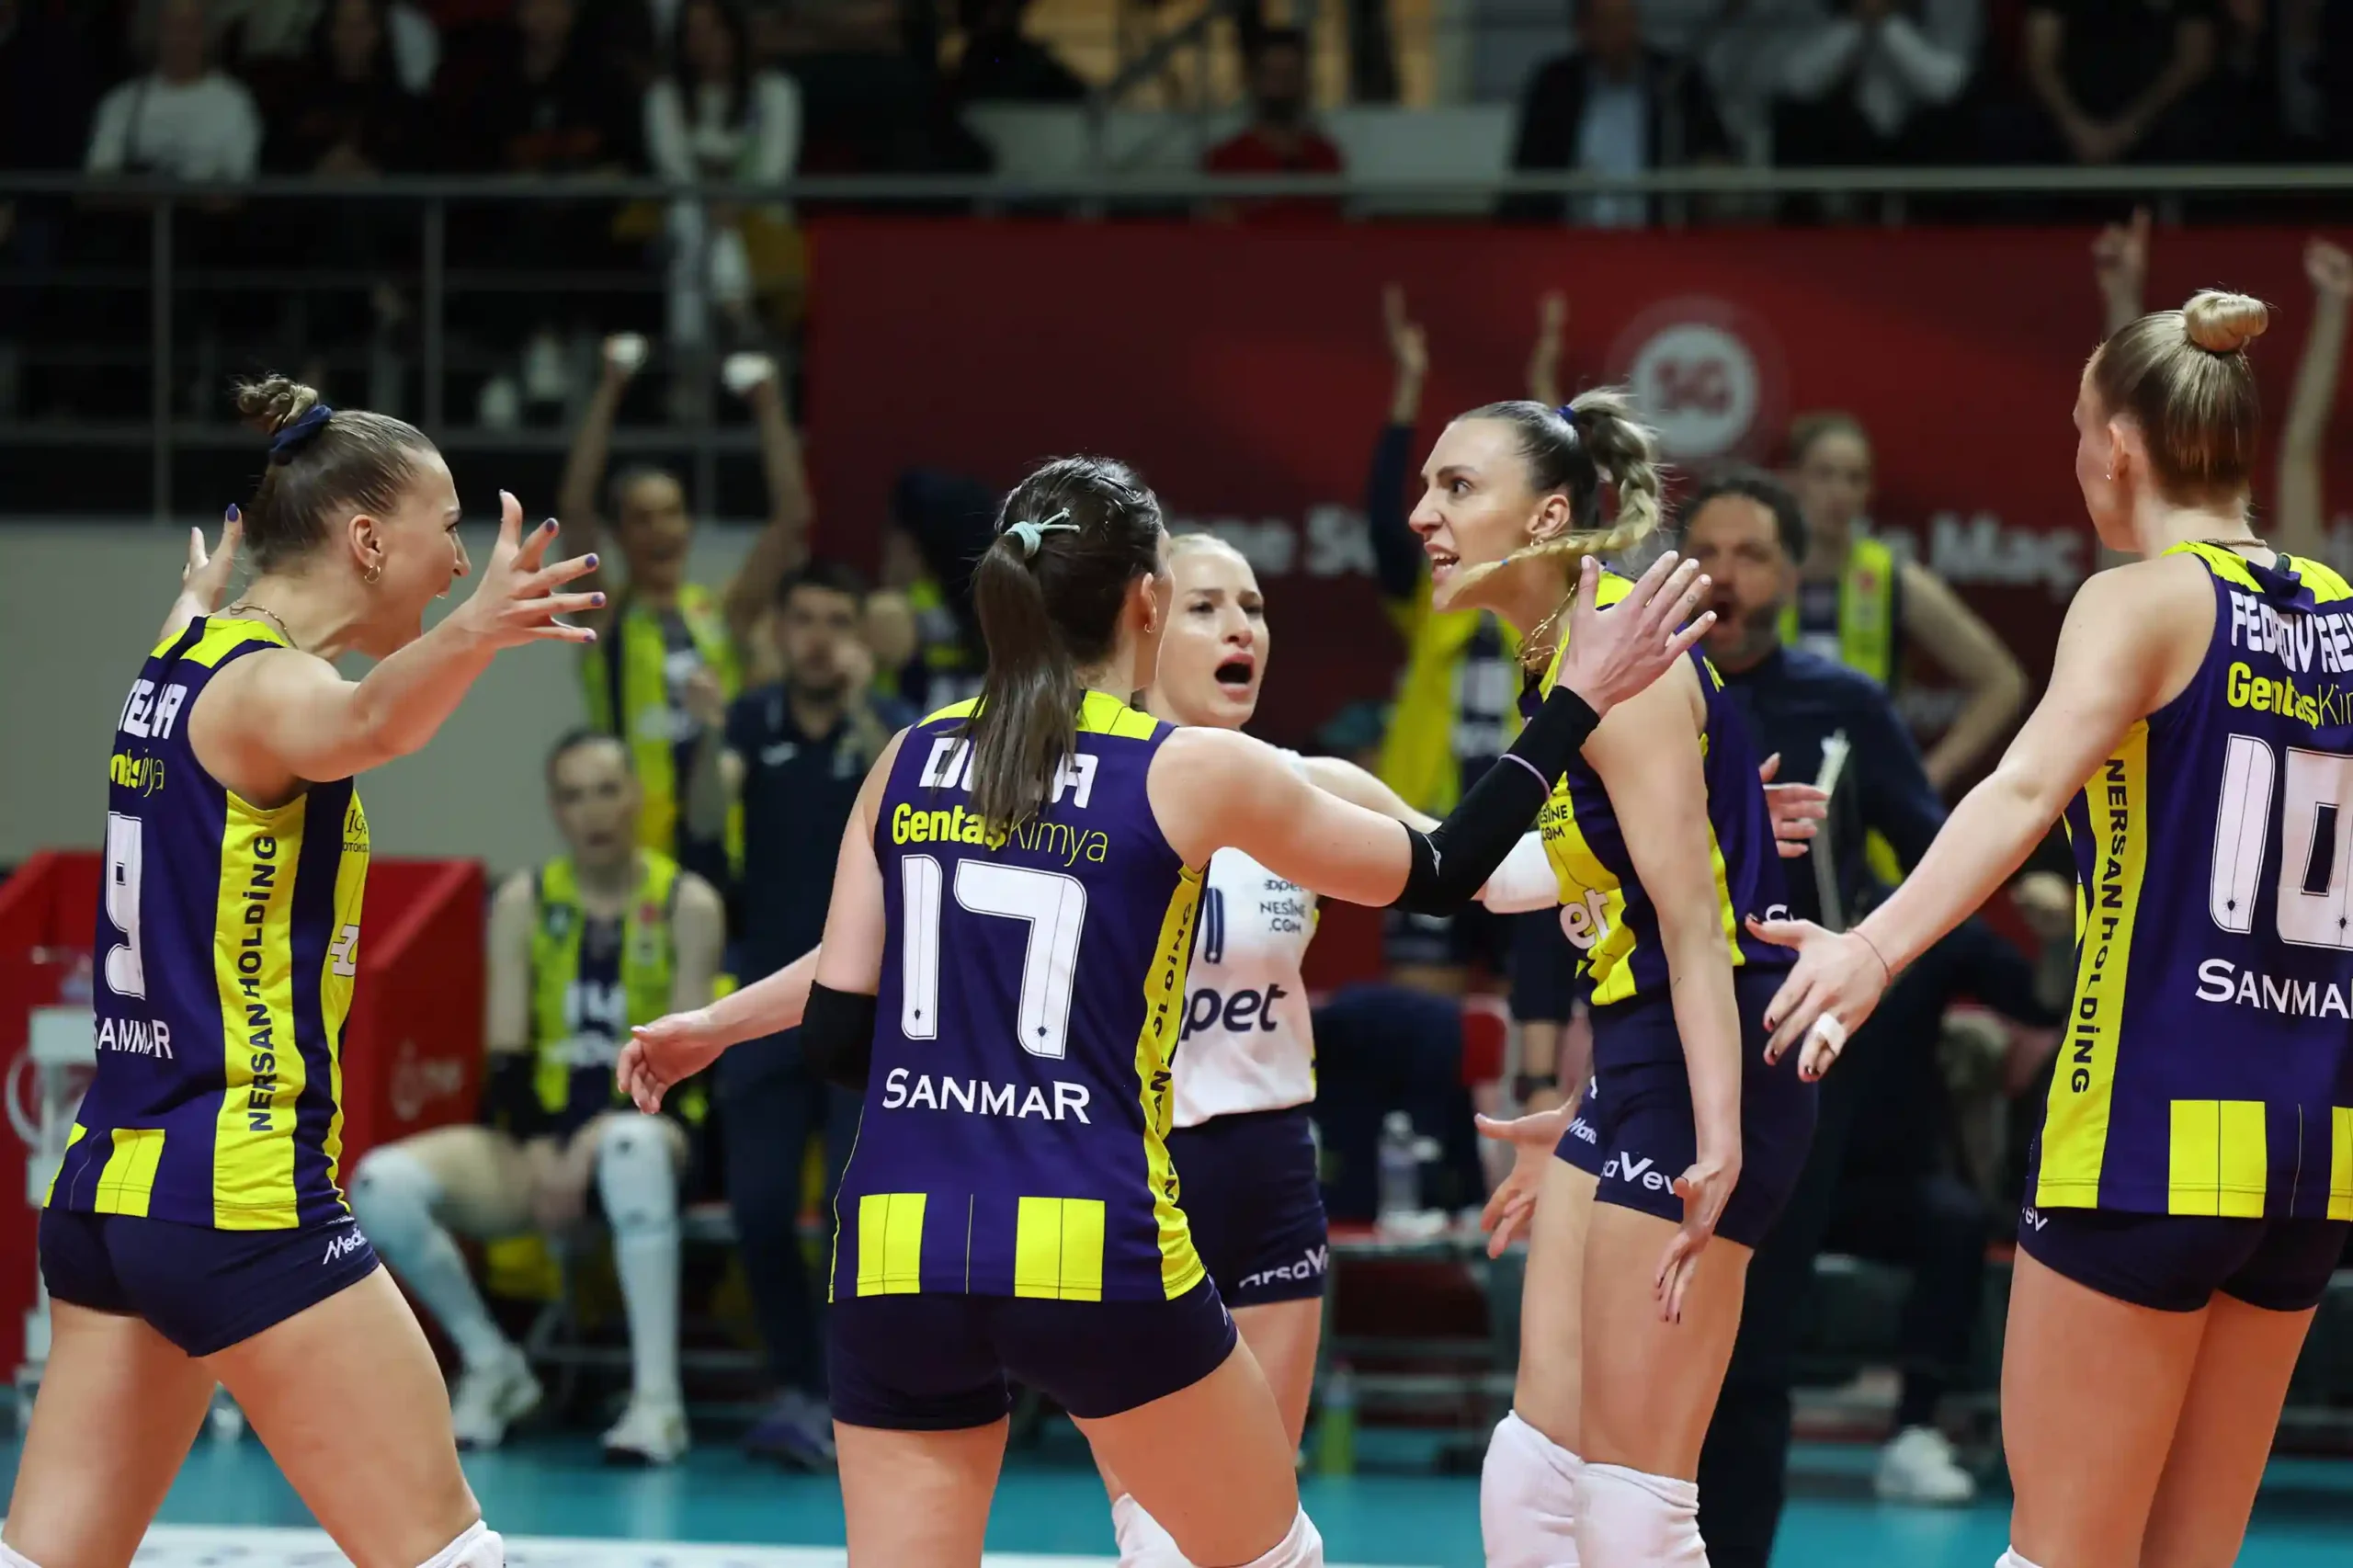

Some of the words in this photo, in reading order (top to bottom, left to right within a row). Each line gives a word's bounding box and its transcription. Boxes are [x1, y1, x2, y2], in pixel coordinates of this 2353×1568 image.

[2210, 733, 2353, 951] 10
[901, 854, 1088, 1061] 17
[1180, 983, 1289, 1041] pet
[2195, 958, 2353, 1020] SANMA
[881, 1067, 1092, 1125] SANMAR
